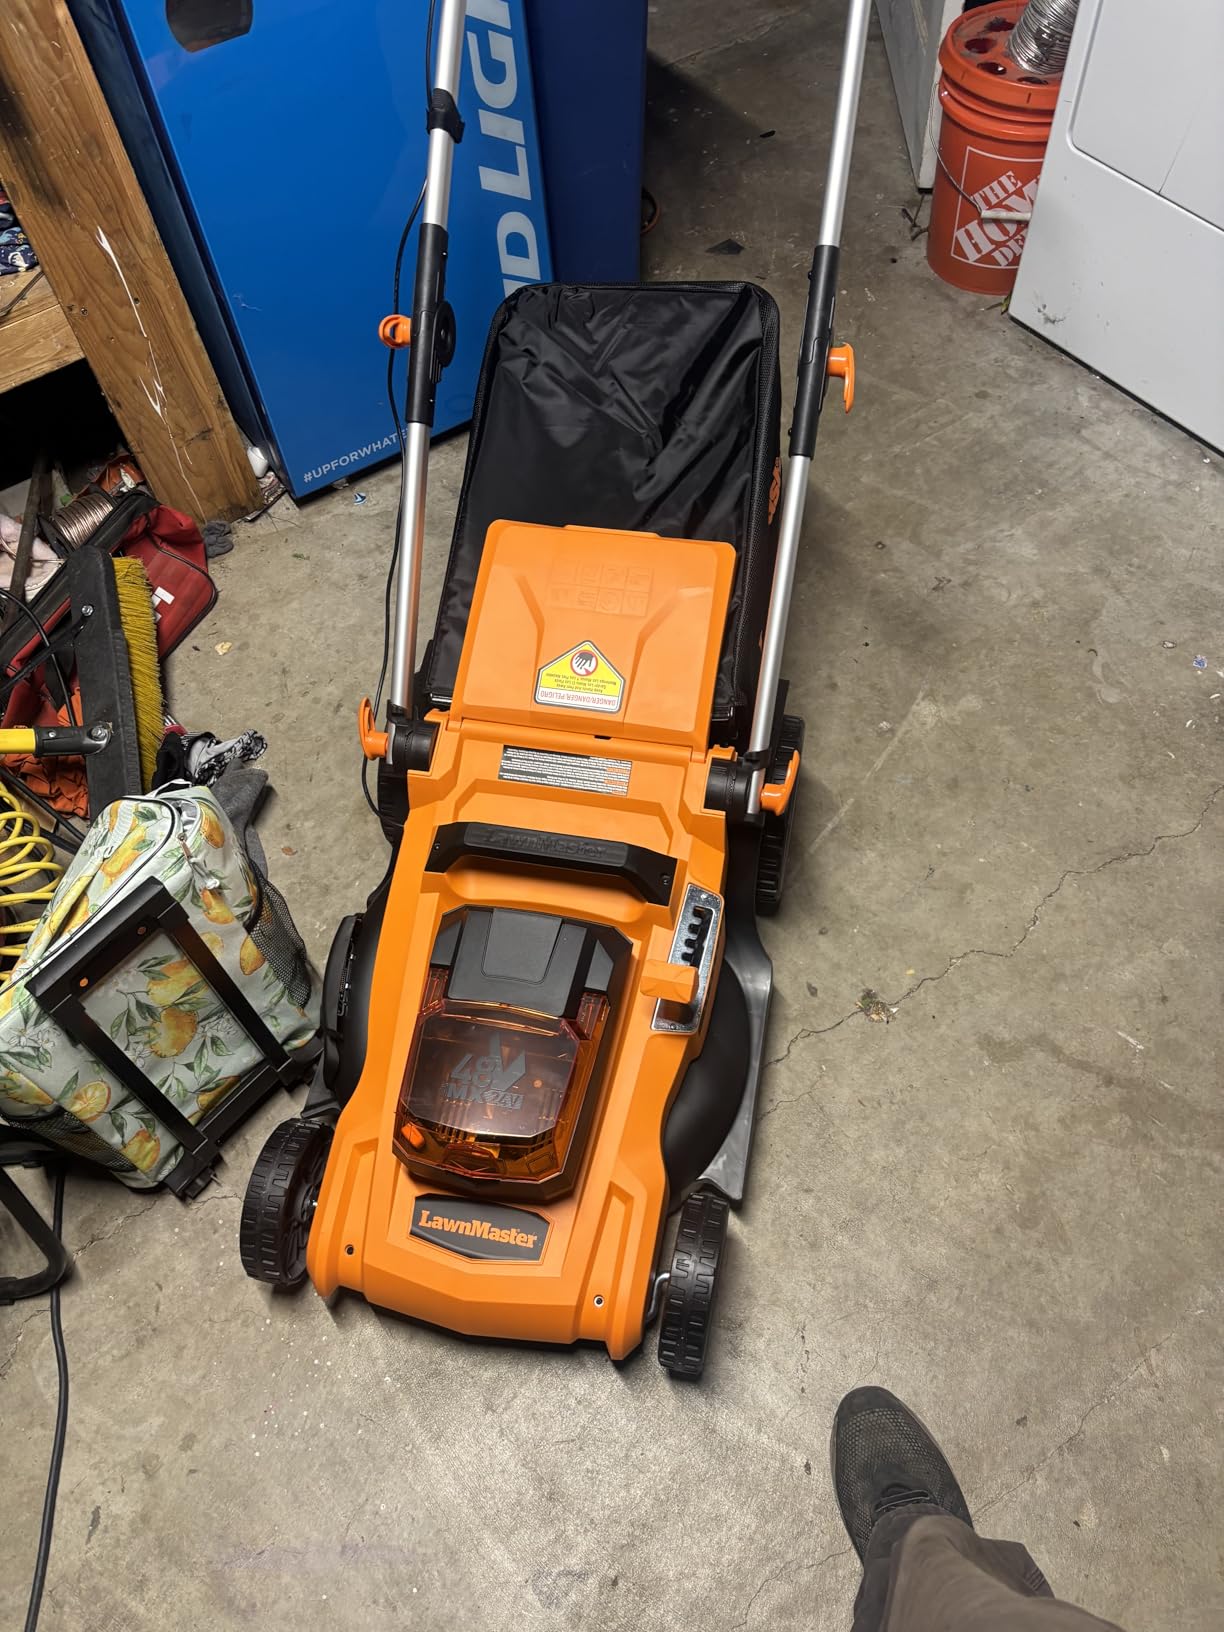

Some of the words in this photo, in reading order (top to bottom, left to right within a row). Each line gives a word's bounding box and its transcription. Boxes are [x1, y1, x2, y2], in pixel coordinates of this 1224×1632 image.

[969, 170, 1023, 212] THE
[303, 428, 408, 483] #UPFORWHATE
[418, 1209, 538, 1249] LawnMaster
